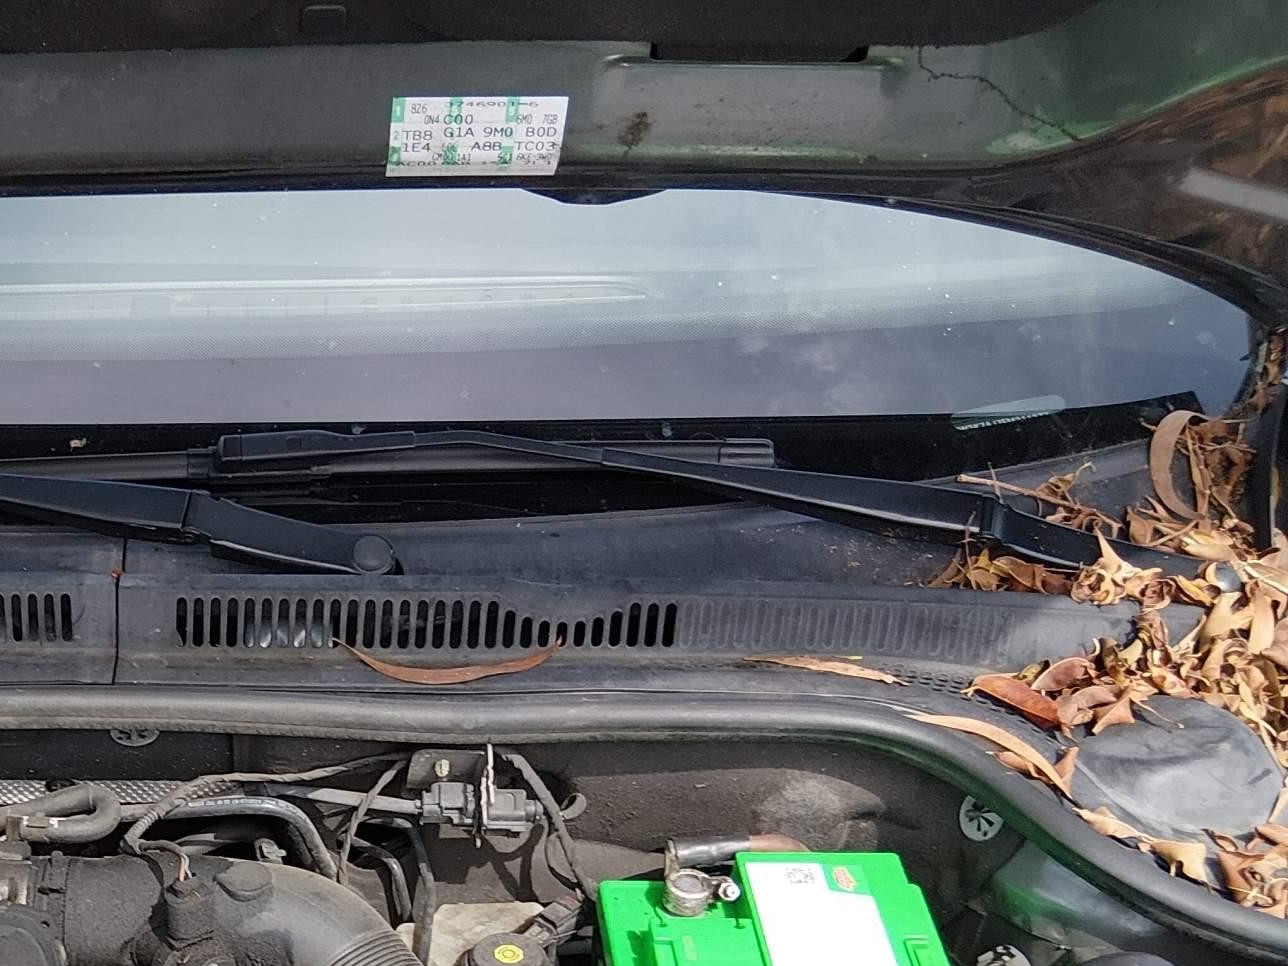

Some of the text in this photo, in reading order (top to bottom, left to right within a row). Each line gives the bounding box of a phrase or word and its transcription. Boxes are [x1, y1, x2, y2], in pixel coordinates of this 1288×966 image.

[403, 130, 433, 141] TB8
[443, 127, 475, 138] G1A
[483, 127, 514, 137] 9M0
[403, 143, 431, 153] 1E4
